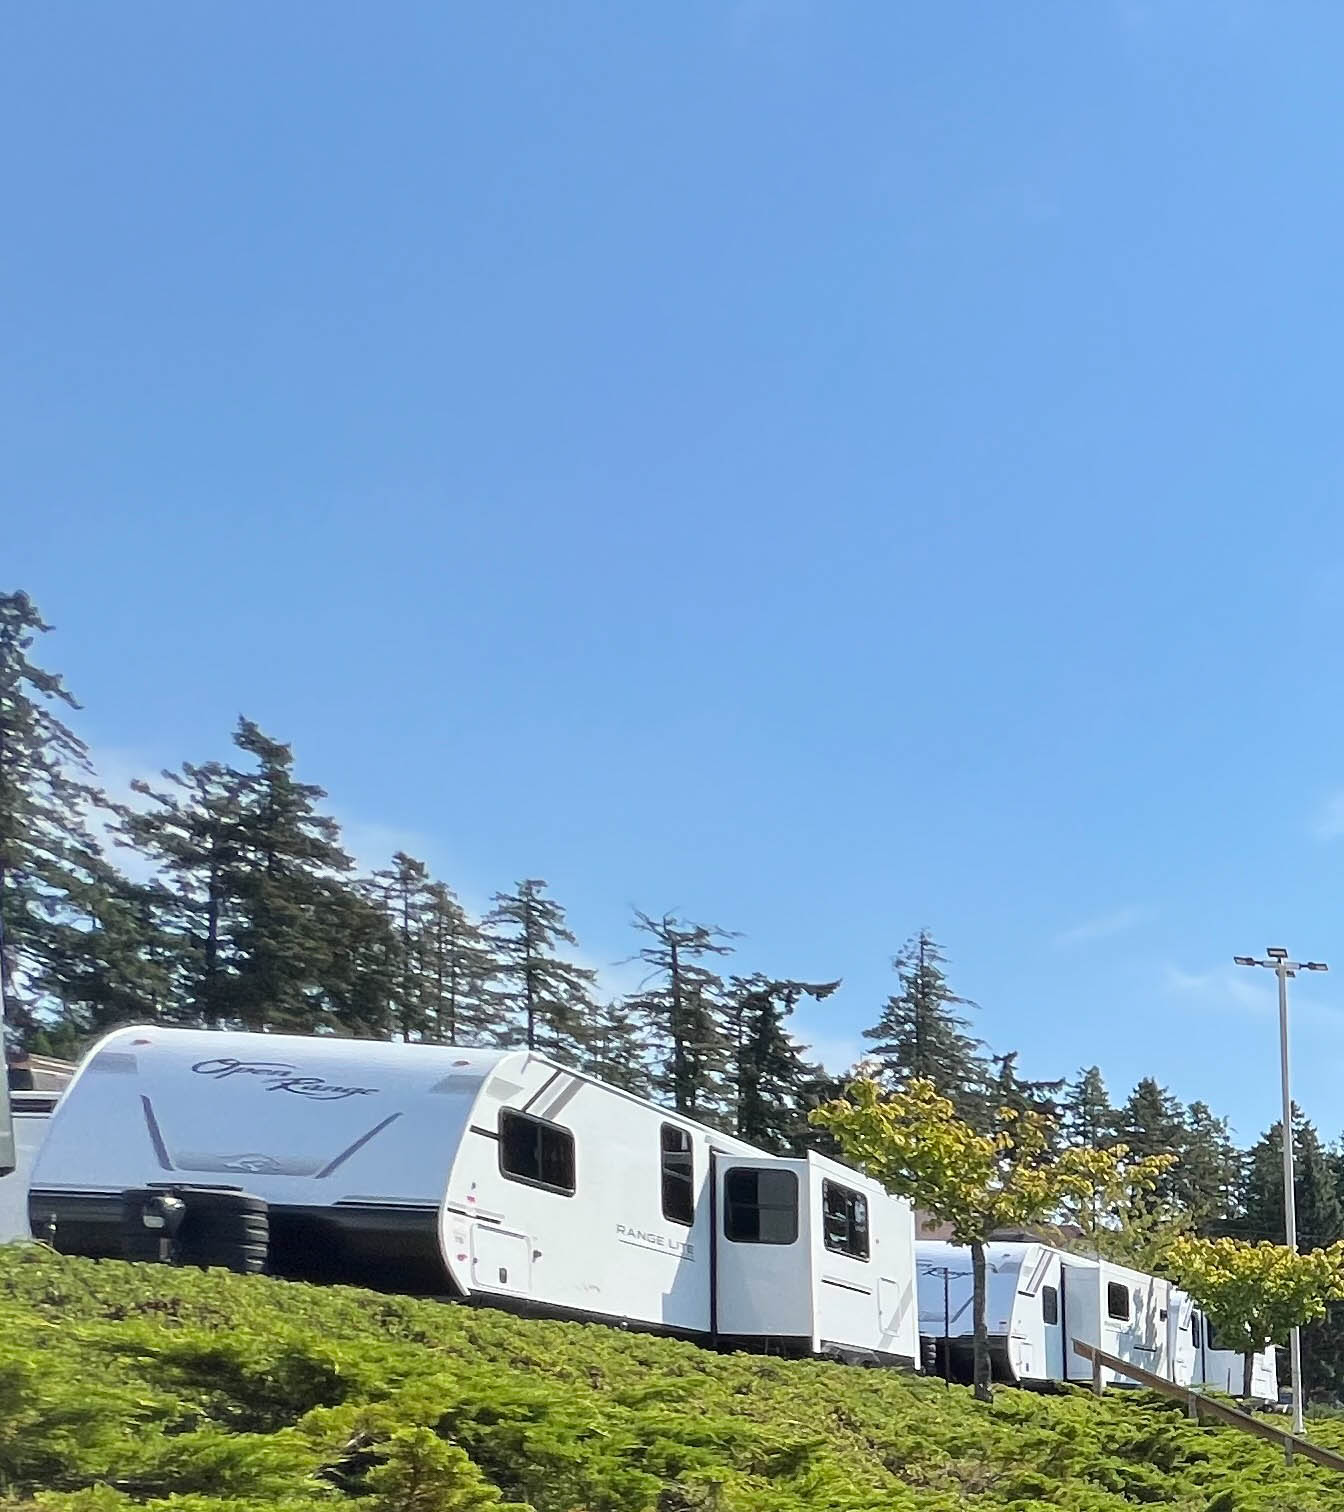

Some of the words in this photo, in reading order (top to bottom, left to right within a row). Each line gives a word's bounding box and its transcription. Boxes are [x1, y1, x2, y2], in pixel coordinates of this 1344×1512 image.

[192, 1058, 298, 1079] Open
[262, 1078, 380, 1100] Range
[616, 1223, 664, 1247] RANGE
[669, 1236, 695, 1255] LITE
